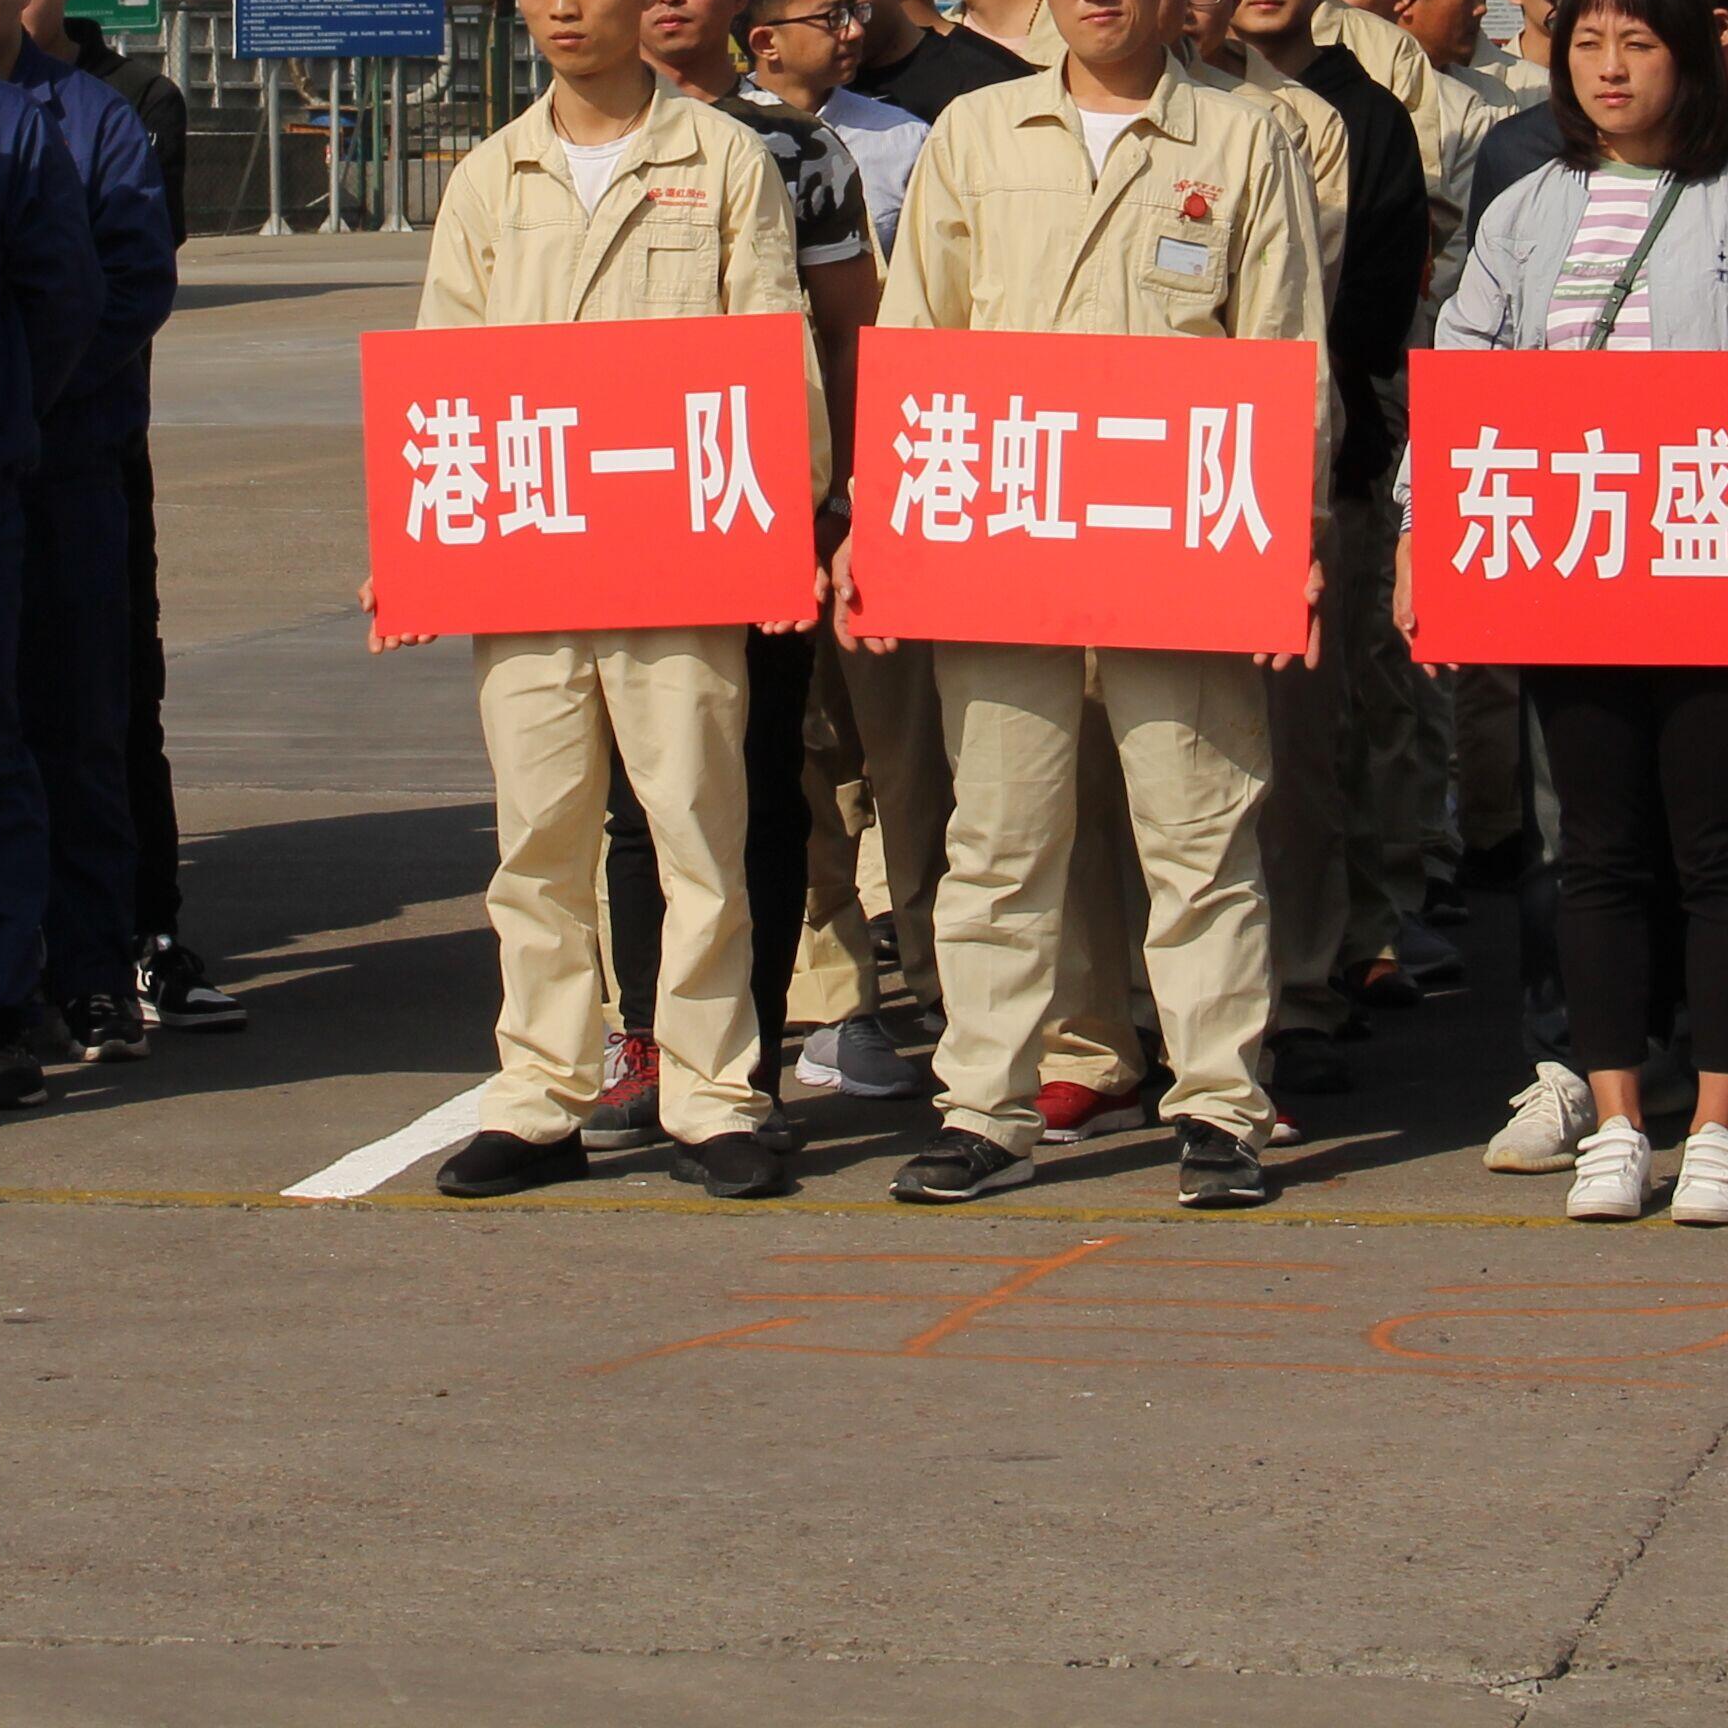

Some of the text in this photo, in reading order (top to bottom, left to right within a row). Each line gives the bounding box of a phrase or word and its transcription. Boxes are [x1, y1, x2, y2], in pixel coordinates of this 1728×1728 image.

[402, 385, 775, 545] 港虹一队
[890, 393, 1272, 554] 港虹二队
